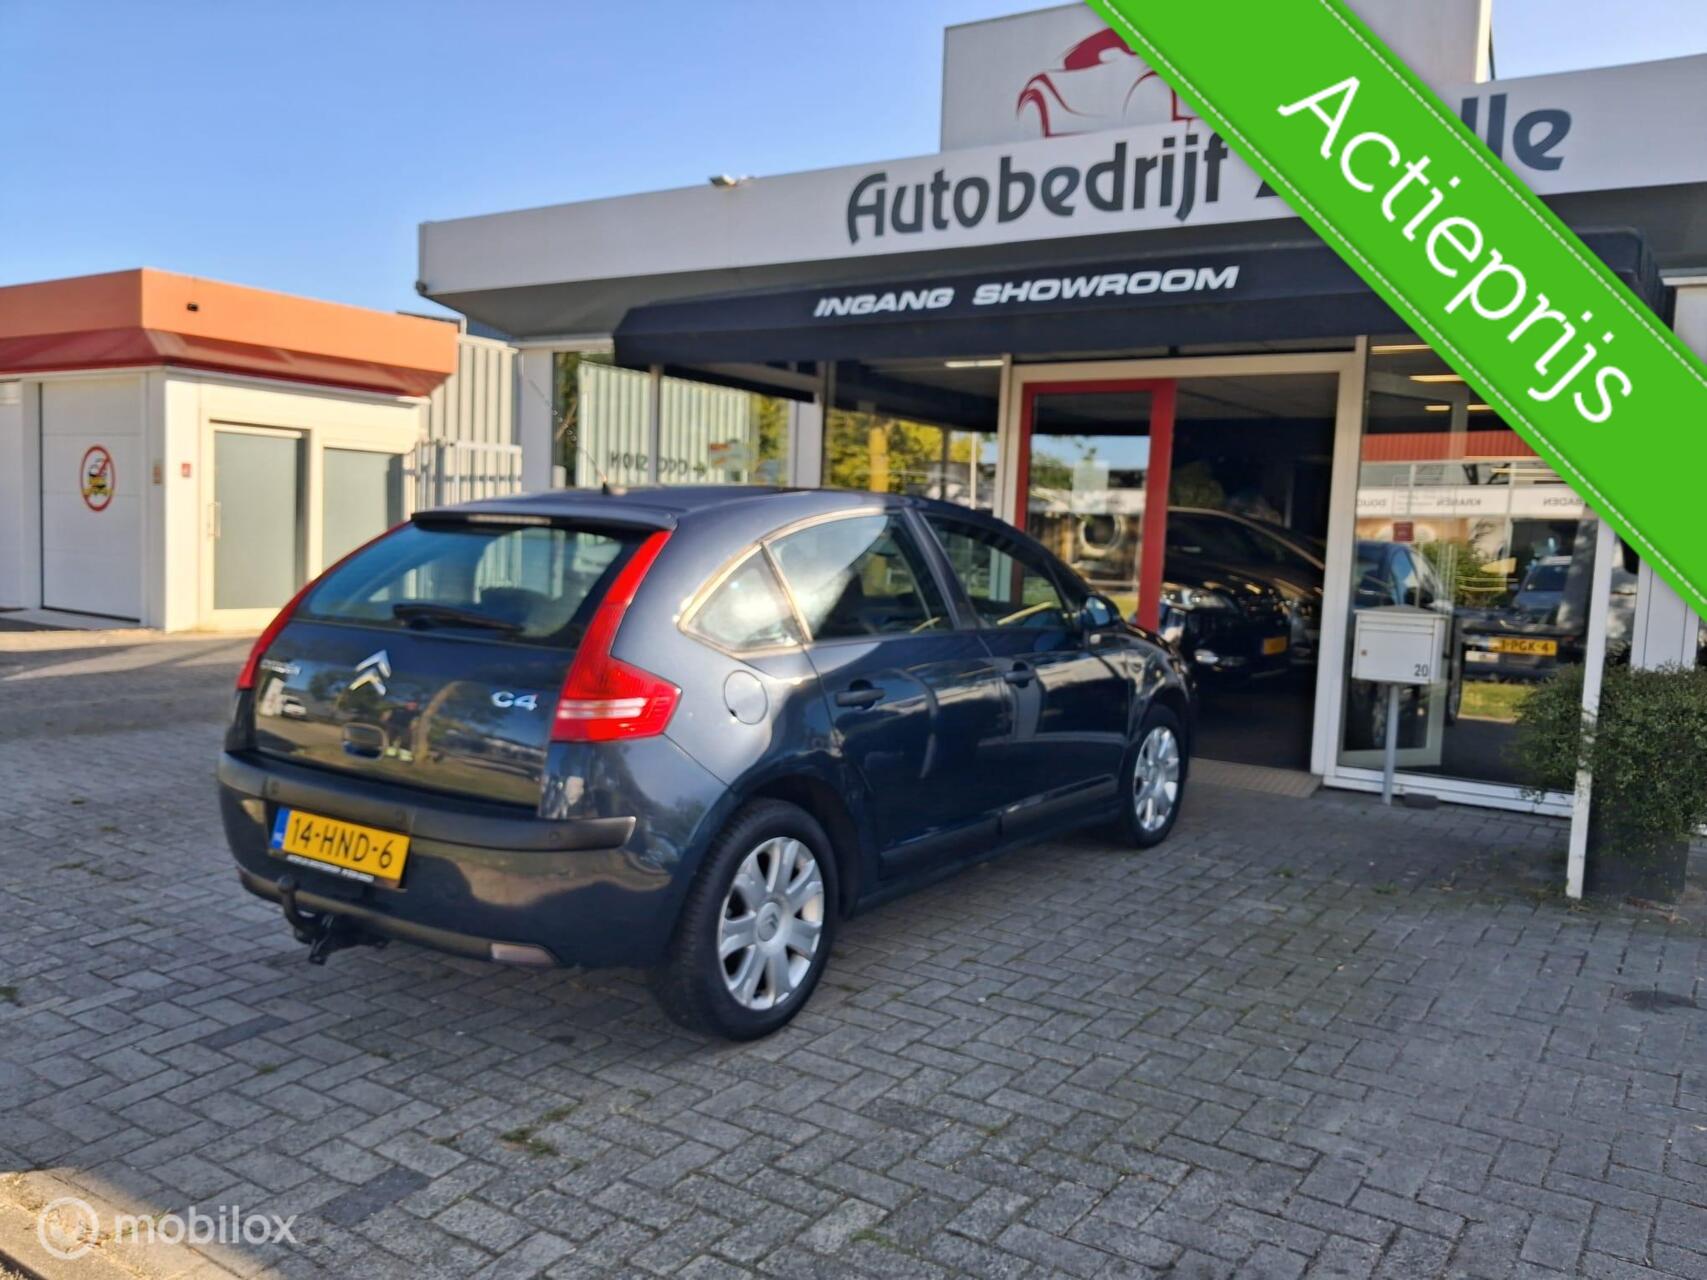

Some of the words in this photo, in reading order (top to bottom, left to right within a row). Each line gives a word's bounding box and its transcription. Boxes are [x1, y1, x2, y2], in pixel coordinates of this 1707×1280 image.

[847, 132, 1228, 243] Autobedrijf
[814, 286, 955, 318] INGANG
[972, 265, 1241, 308] SHOWROOM
[1414, 664, 1429, 677] 20
[491, 690, 539, 712] C4
[291, 817, 393, 869] 14-HND-6
